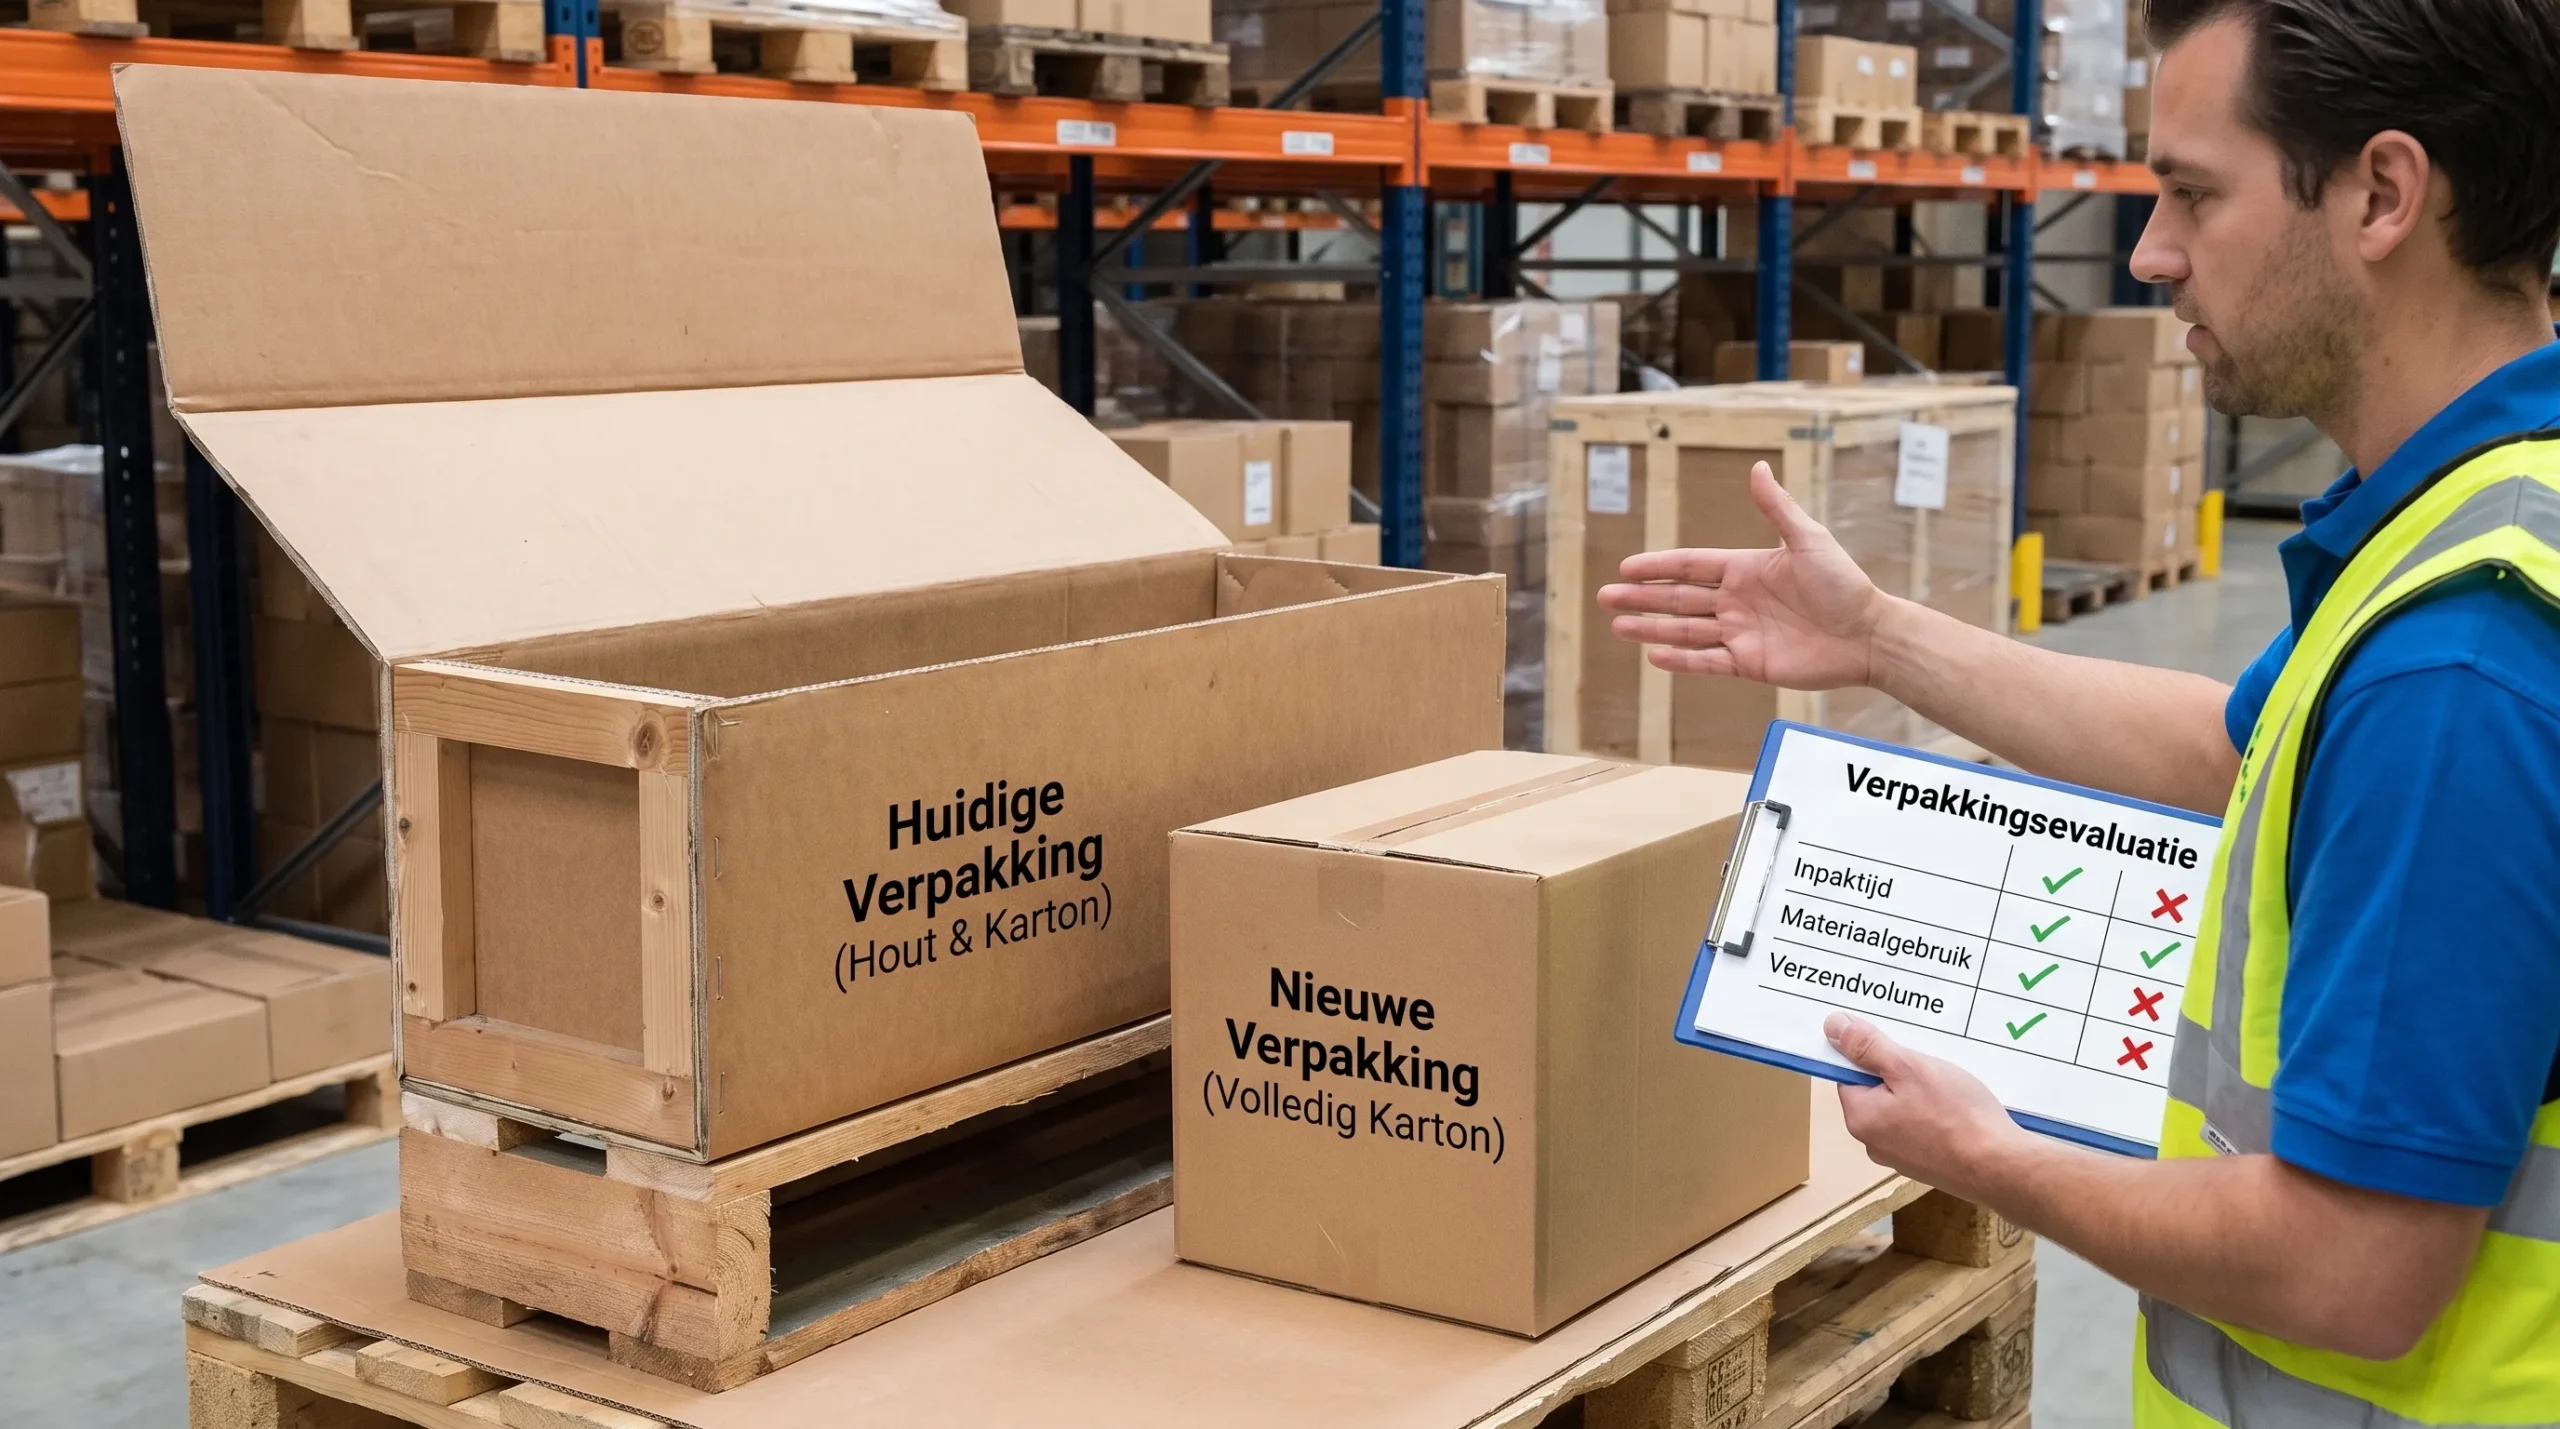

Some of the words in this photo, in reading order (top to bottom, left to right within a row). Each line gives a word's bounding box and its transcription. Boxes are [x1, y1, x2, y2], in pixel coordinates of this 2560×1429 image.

[889, 779, 1066, 851] Huidige
[1845, 763, 2199, 870] Verpakkingsevaluatie
[842, 833, 1104, 922] Verpakking
[1793, 857, 1894, 899] Inpaktijd
[834, 928, 938, 995] (Hout
[949, 918, 974, 957] &
[985, 881, 1113, 949] Karton)
[1780, 904, 1973, 971] Materiaalgebruik
[1270, 966, 1436, 1031] Nieuwe
[1769, 952, 1945, 1015] Verzendvolume
[1225, 1017, 1480, 1108] Verpakking
[1203, 1070, 1357, 1140] (Volledig
[1370, 1099, 1505, 1165] Karton)
